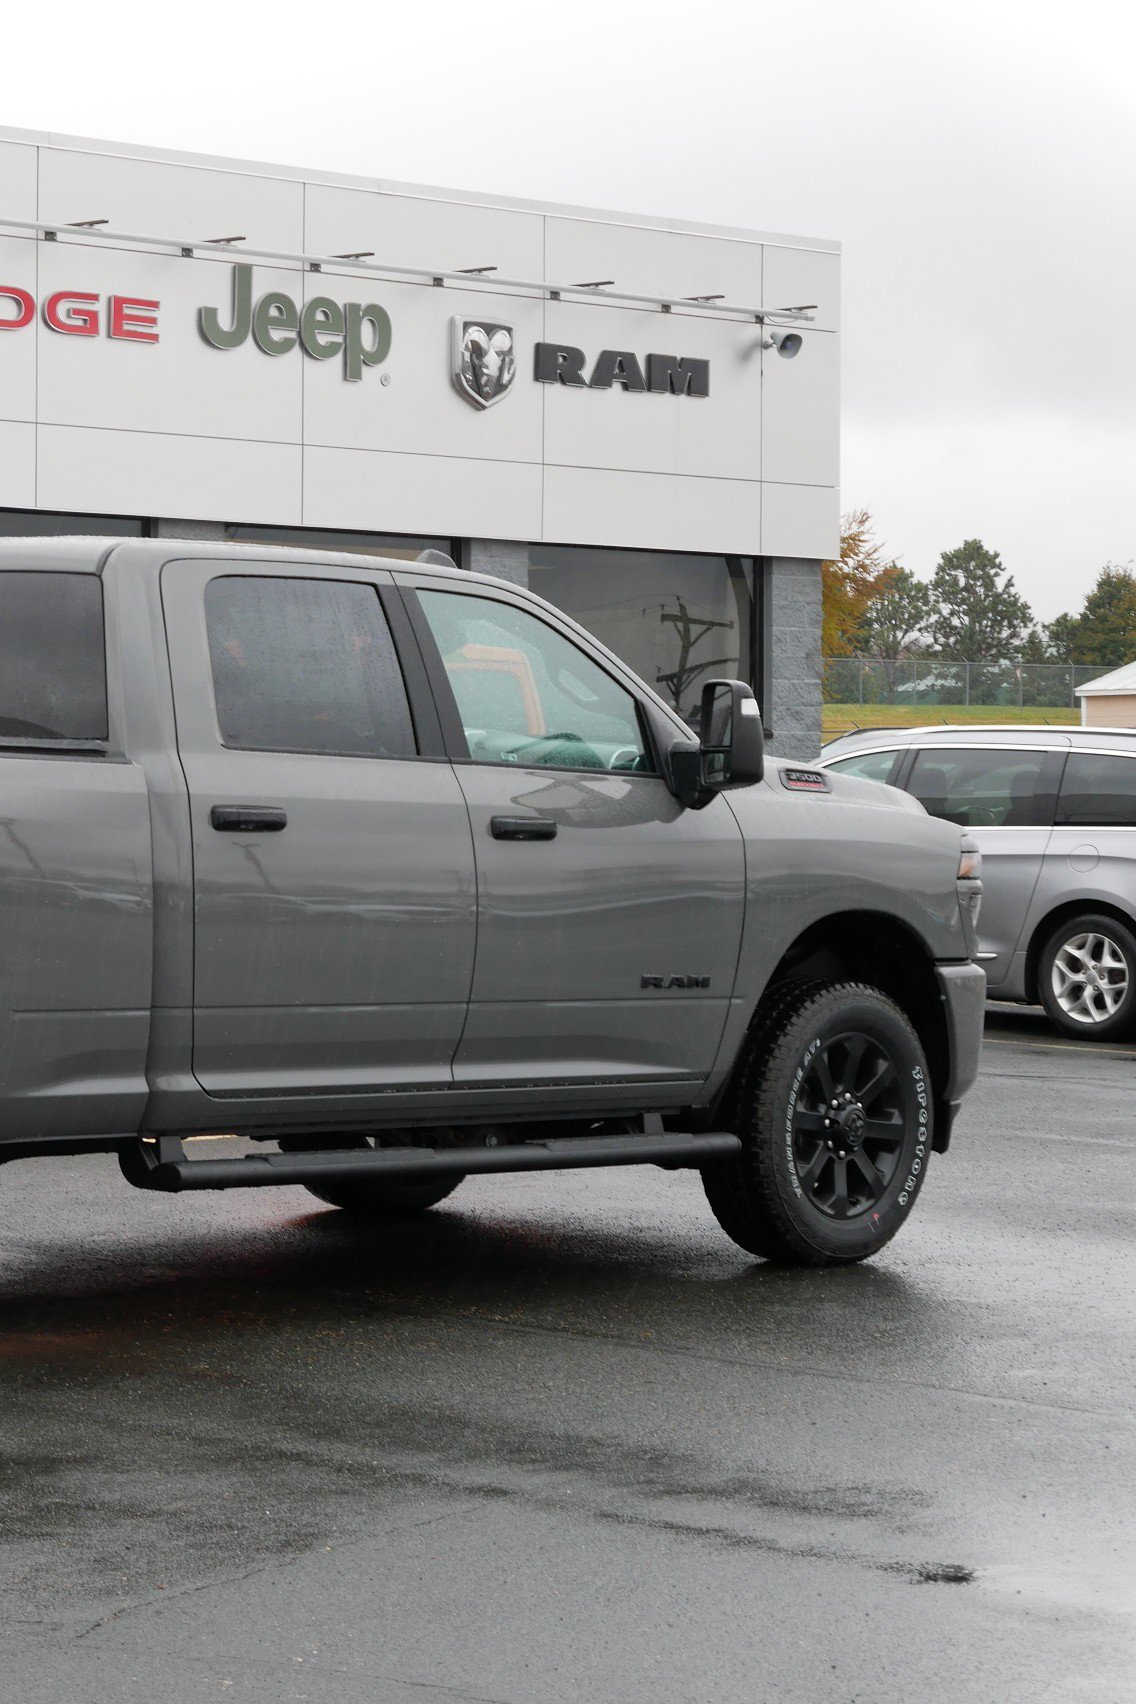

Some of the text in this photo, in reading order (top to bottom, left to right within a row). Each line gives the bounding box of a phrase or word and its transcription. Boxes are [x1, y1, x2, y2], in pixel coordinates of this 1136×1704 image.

[199, 264, 393, 382] Jeep
[534, 341, 711, 398] RAM
[785, 771, 822, 783] 3500
[640, 974, 711, 989] RAM
